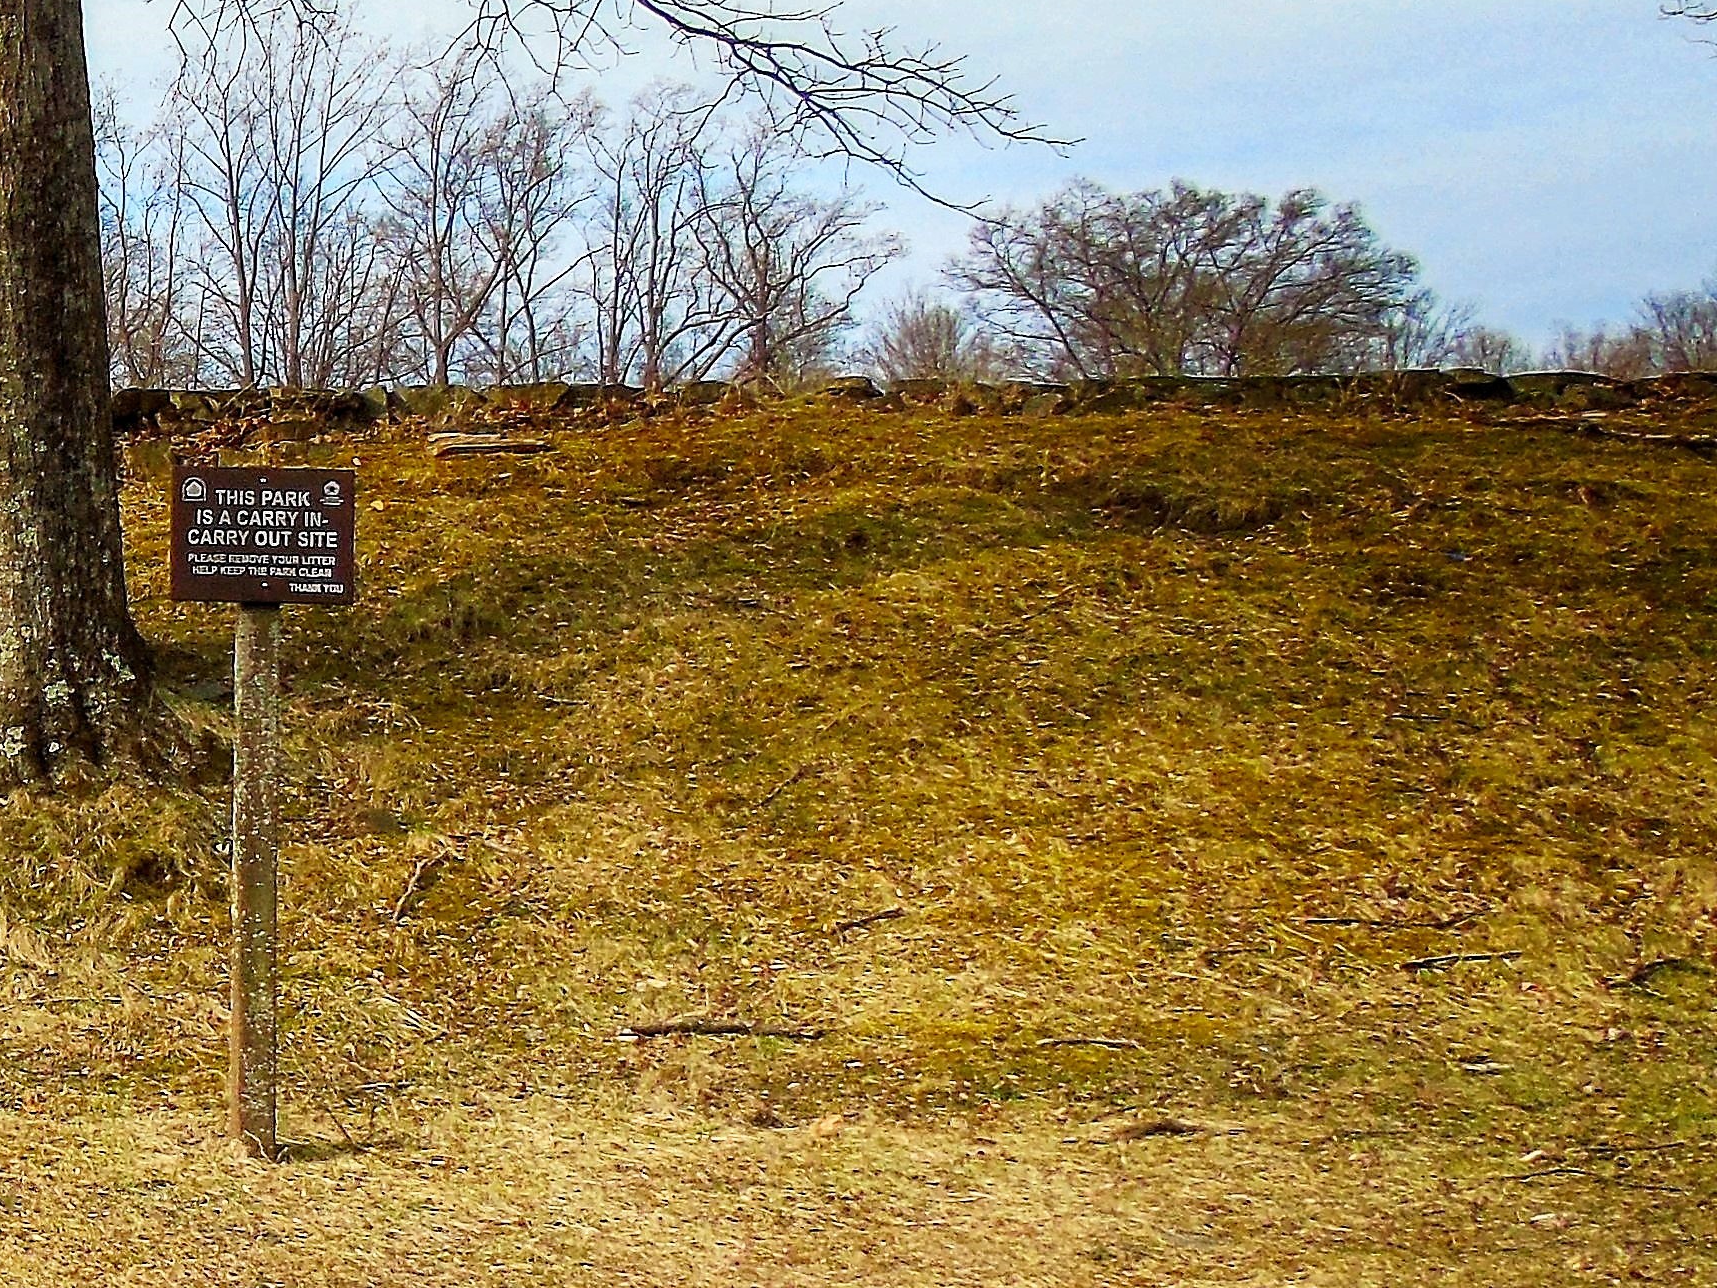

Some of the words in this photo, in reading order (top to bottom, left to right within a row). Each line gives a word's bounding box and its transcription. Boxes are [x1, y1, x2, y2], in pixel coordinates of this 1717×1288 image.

[215, 489, 255, 505] THIS
[262, 491, 310, 507] PARK
[197, 509, 213, 525] IS
[219, 510, 231, 525] A
[237, 510, 298, 526] CARRY
[304, 512, 329, 527] IN-
[187, 530, 250, 545] CARRY
[255, 531, 292, 546] OUT
[297, 531, 337, 547] SITE
[188, 553, 226, 563] PLEASE
[229, 555, 269, 564] REMOVE
[272, 556, 299, 564] YOUR
[302, 557, 335, 565] LITTER
[193, 566, 217, 575] HELP
[220, 567, 246, 575] KEEP
[248, 567, 268, 576] THE
[270, 568, 296, 576] PARK
[299, 568, 332, 577] CLEAN
[289, 583, 321, 593] THANK
[323, 584, 343, 593] YOU
